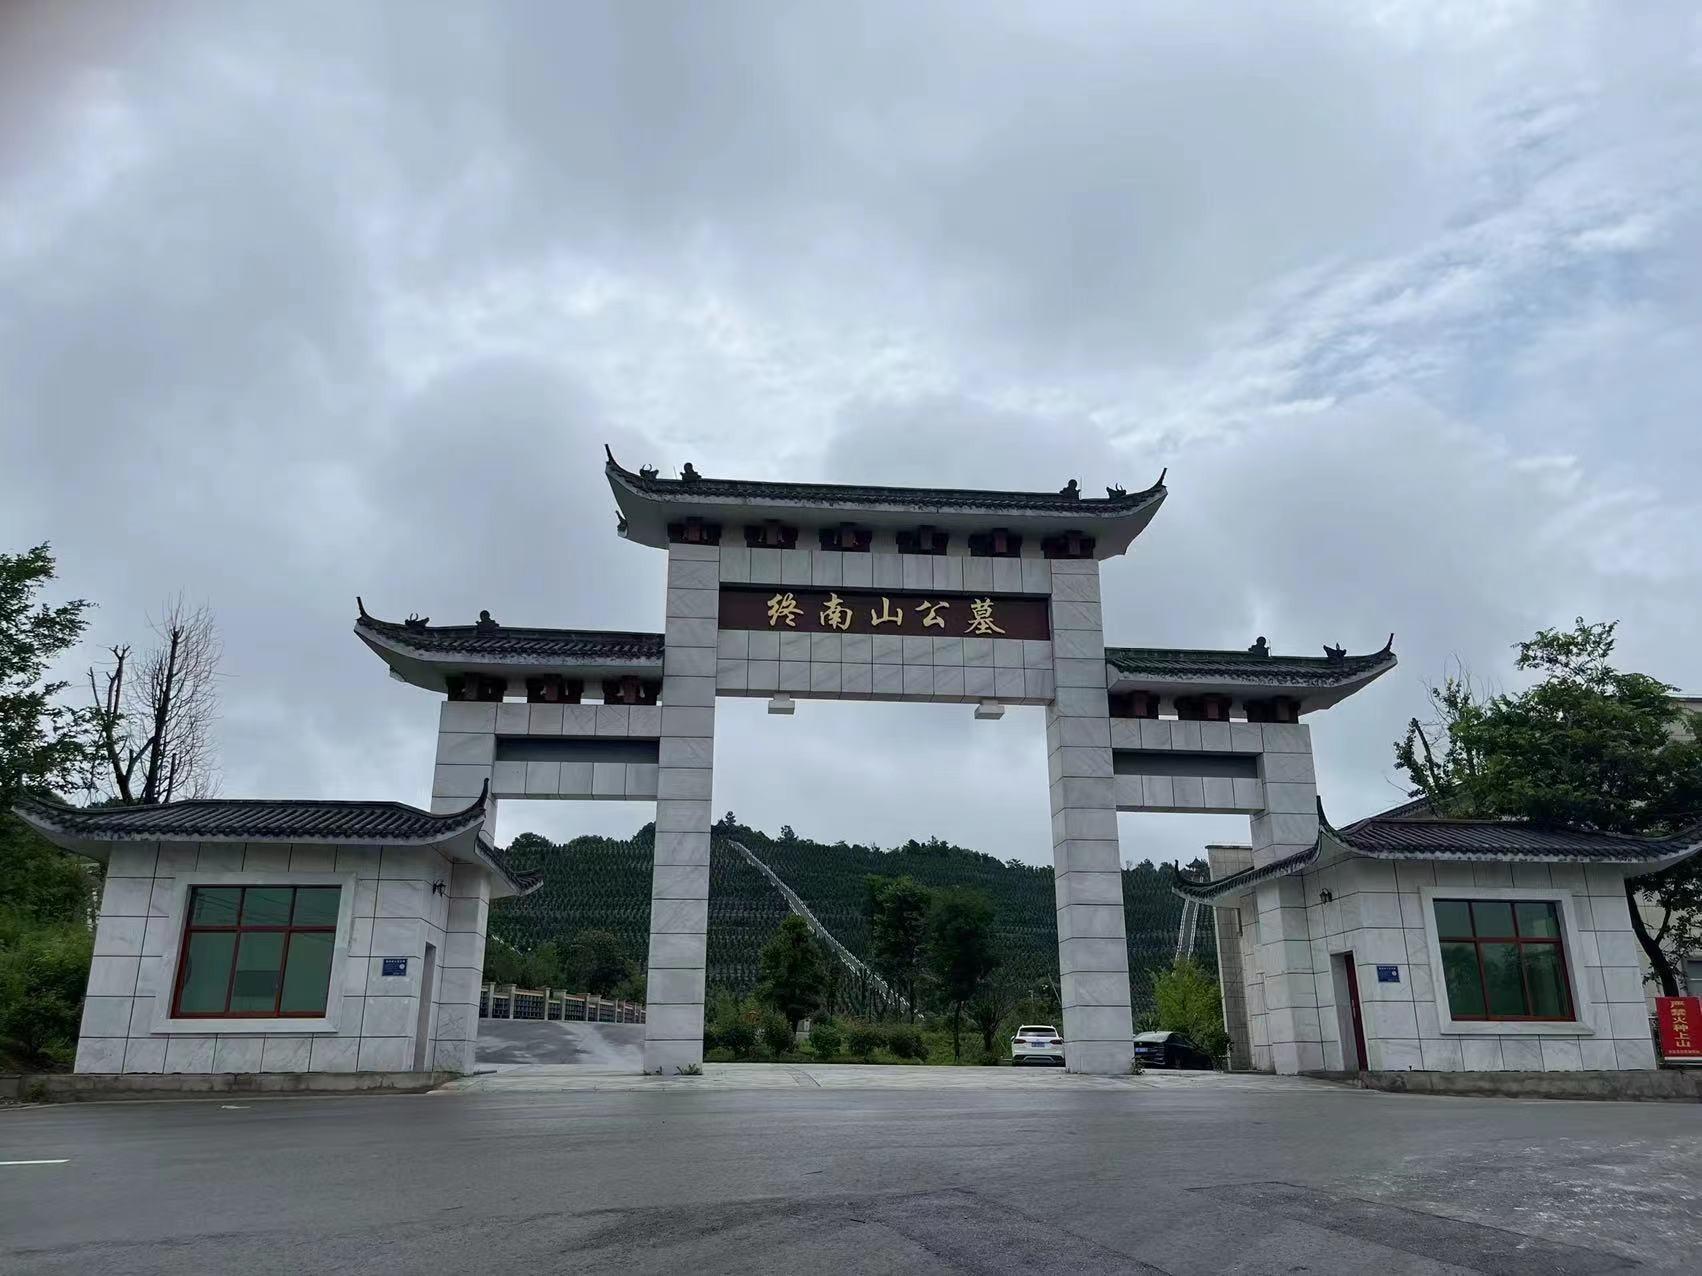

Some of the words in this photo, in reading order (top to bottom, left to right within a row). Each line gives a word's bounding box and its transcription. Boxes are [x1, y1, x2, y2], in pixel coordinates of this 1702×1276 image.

[766, 592, 1005, 635] 终南山公墓
